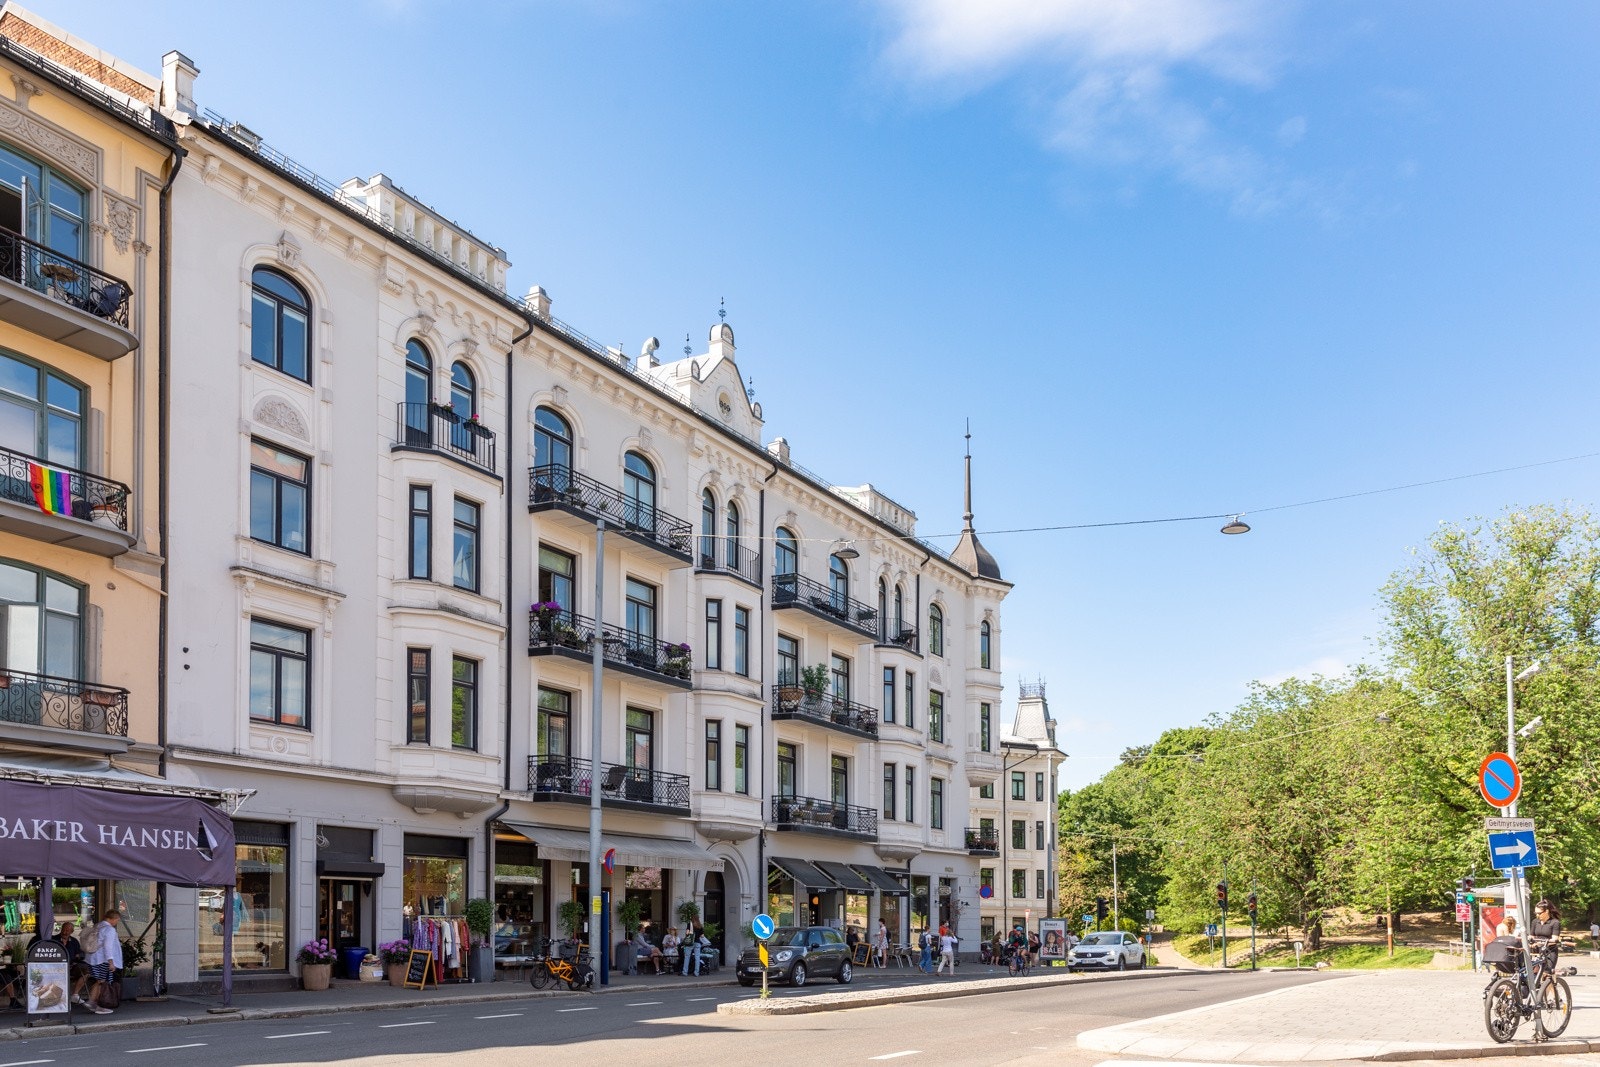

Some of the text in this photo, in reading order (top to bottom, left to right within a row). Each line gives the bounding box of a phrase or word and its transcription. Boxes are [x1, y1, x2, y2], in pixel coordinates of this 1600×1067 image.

[0, 817, 199, 850] BAKER HANSEN
[1488, 819, 1533, 829] Geitmyrsveien
